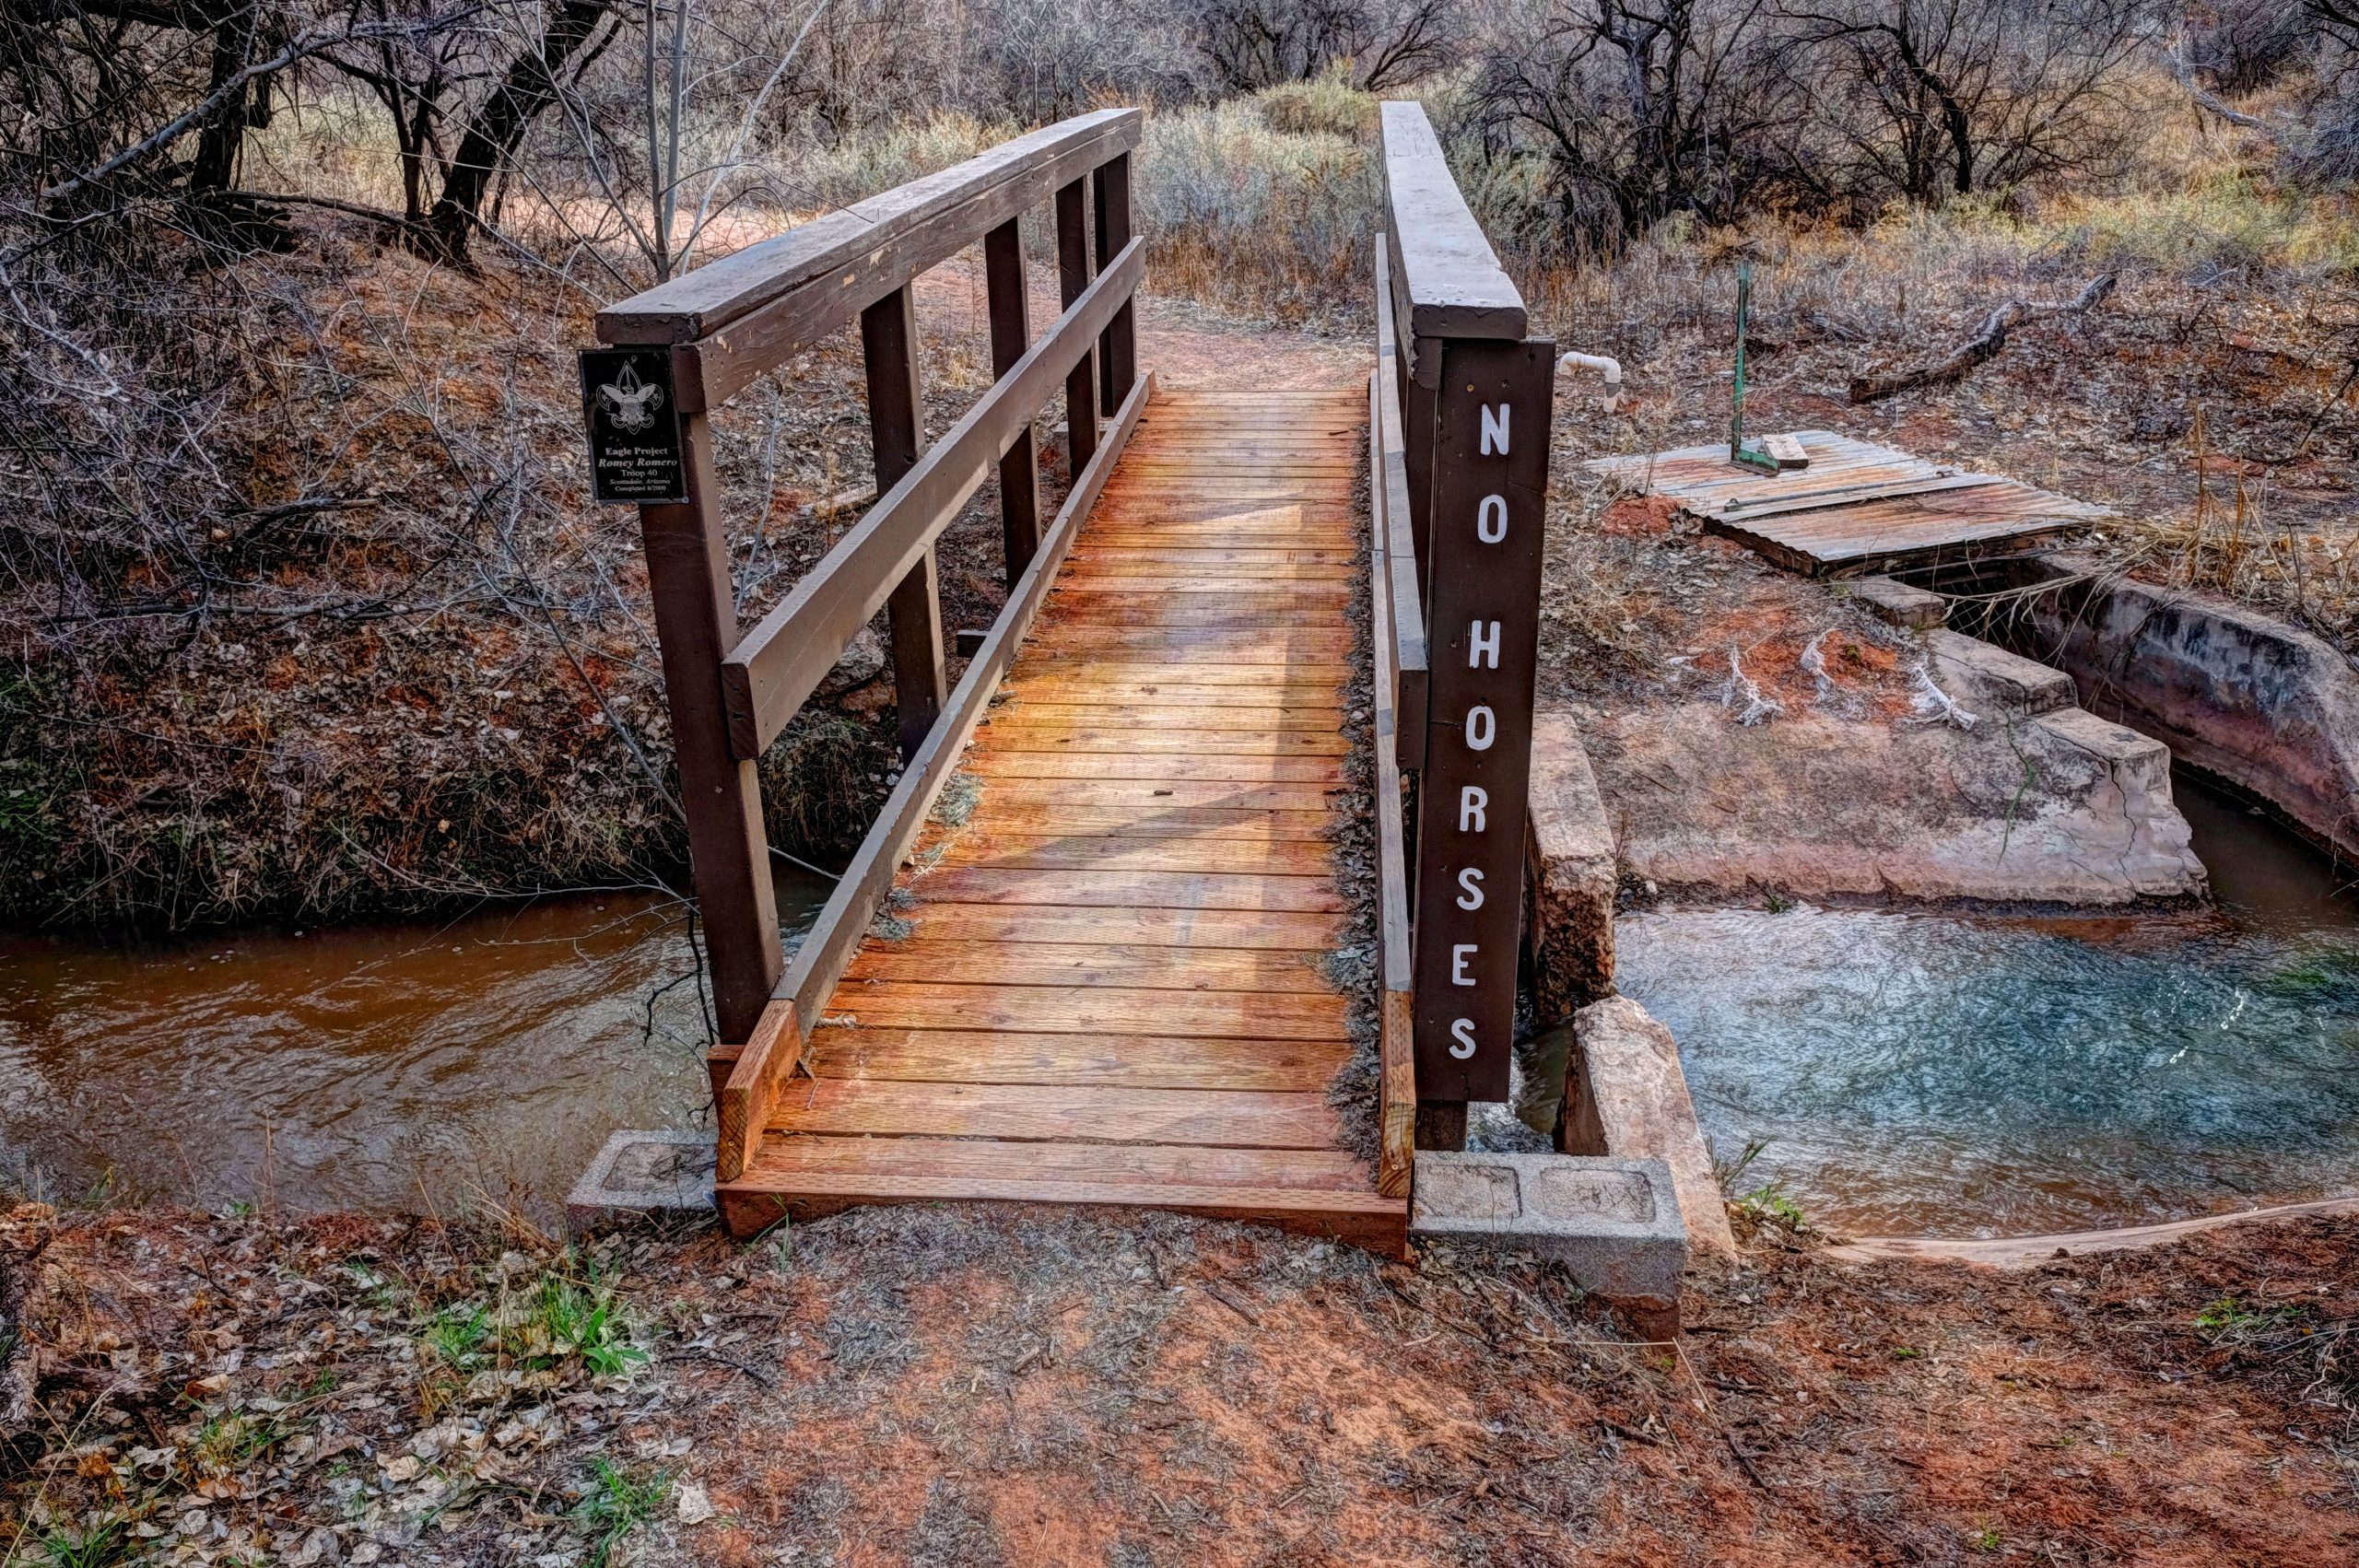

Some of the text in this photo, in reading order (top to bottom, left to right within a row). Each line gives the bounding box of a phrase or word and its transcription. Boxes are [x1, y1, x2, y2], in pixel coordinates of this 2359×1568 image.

[604, 447, 669, 457] Eagle Project
[598, 458, 677, 467] Romey Romero
[620, 469, 645, 478] Troop
[1449, 404, 1511, 1059] NO HORSES
